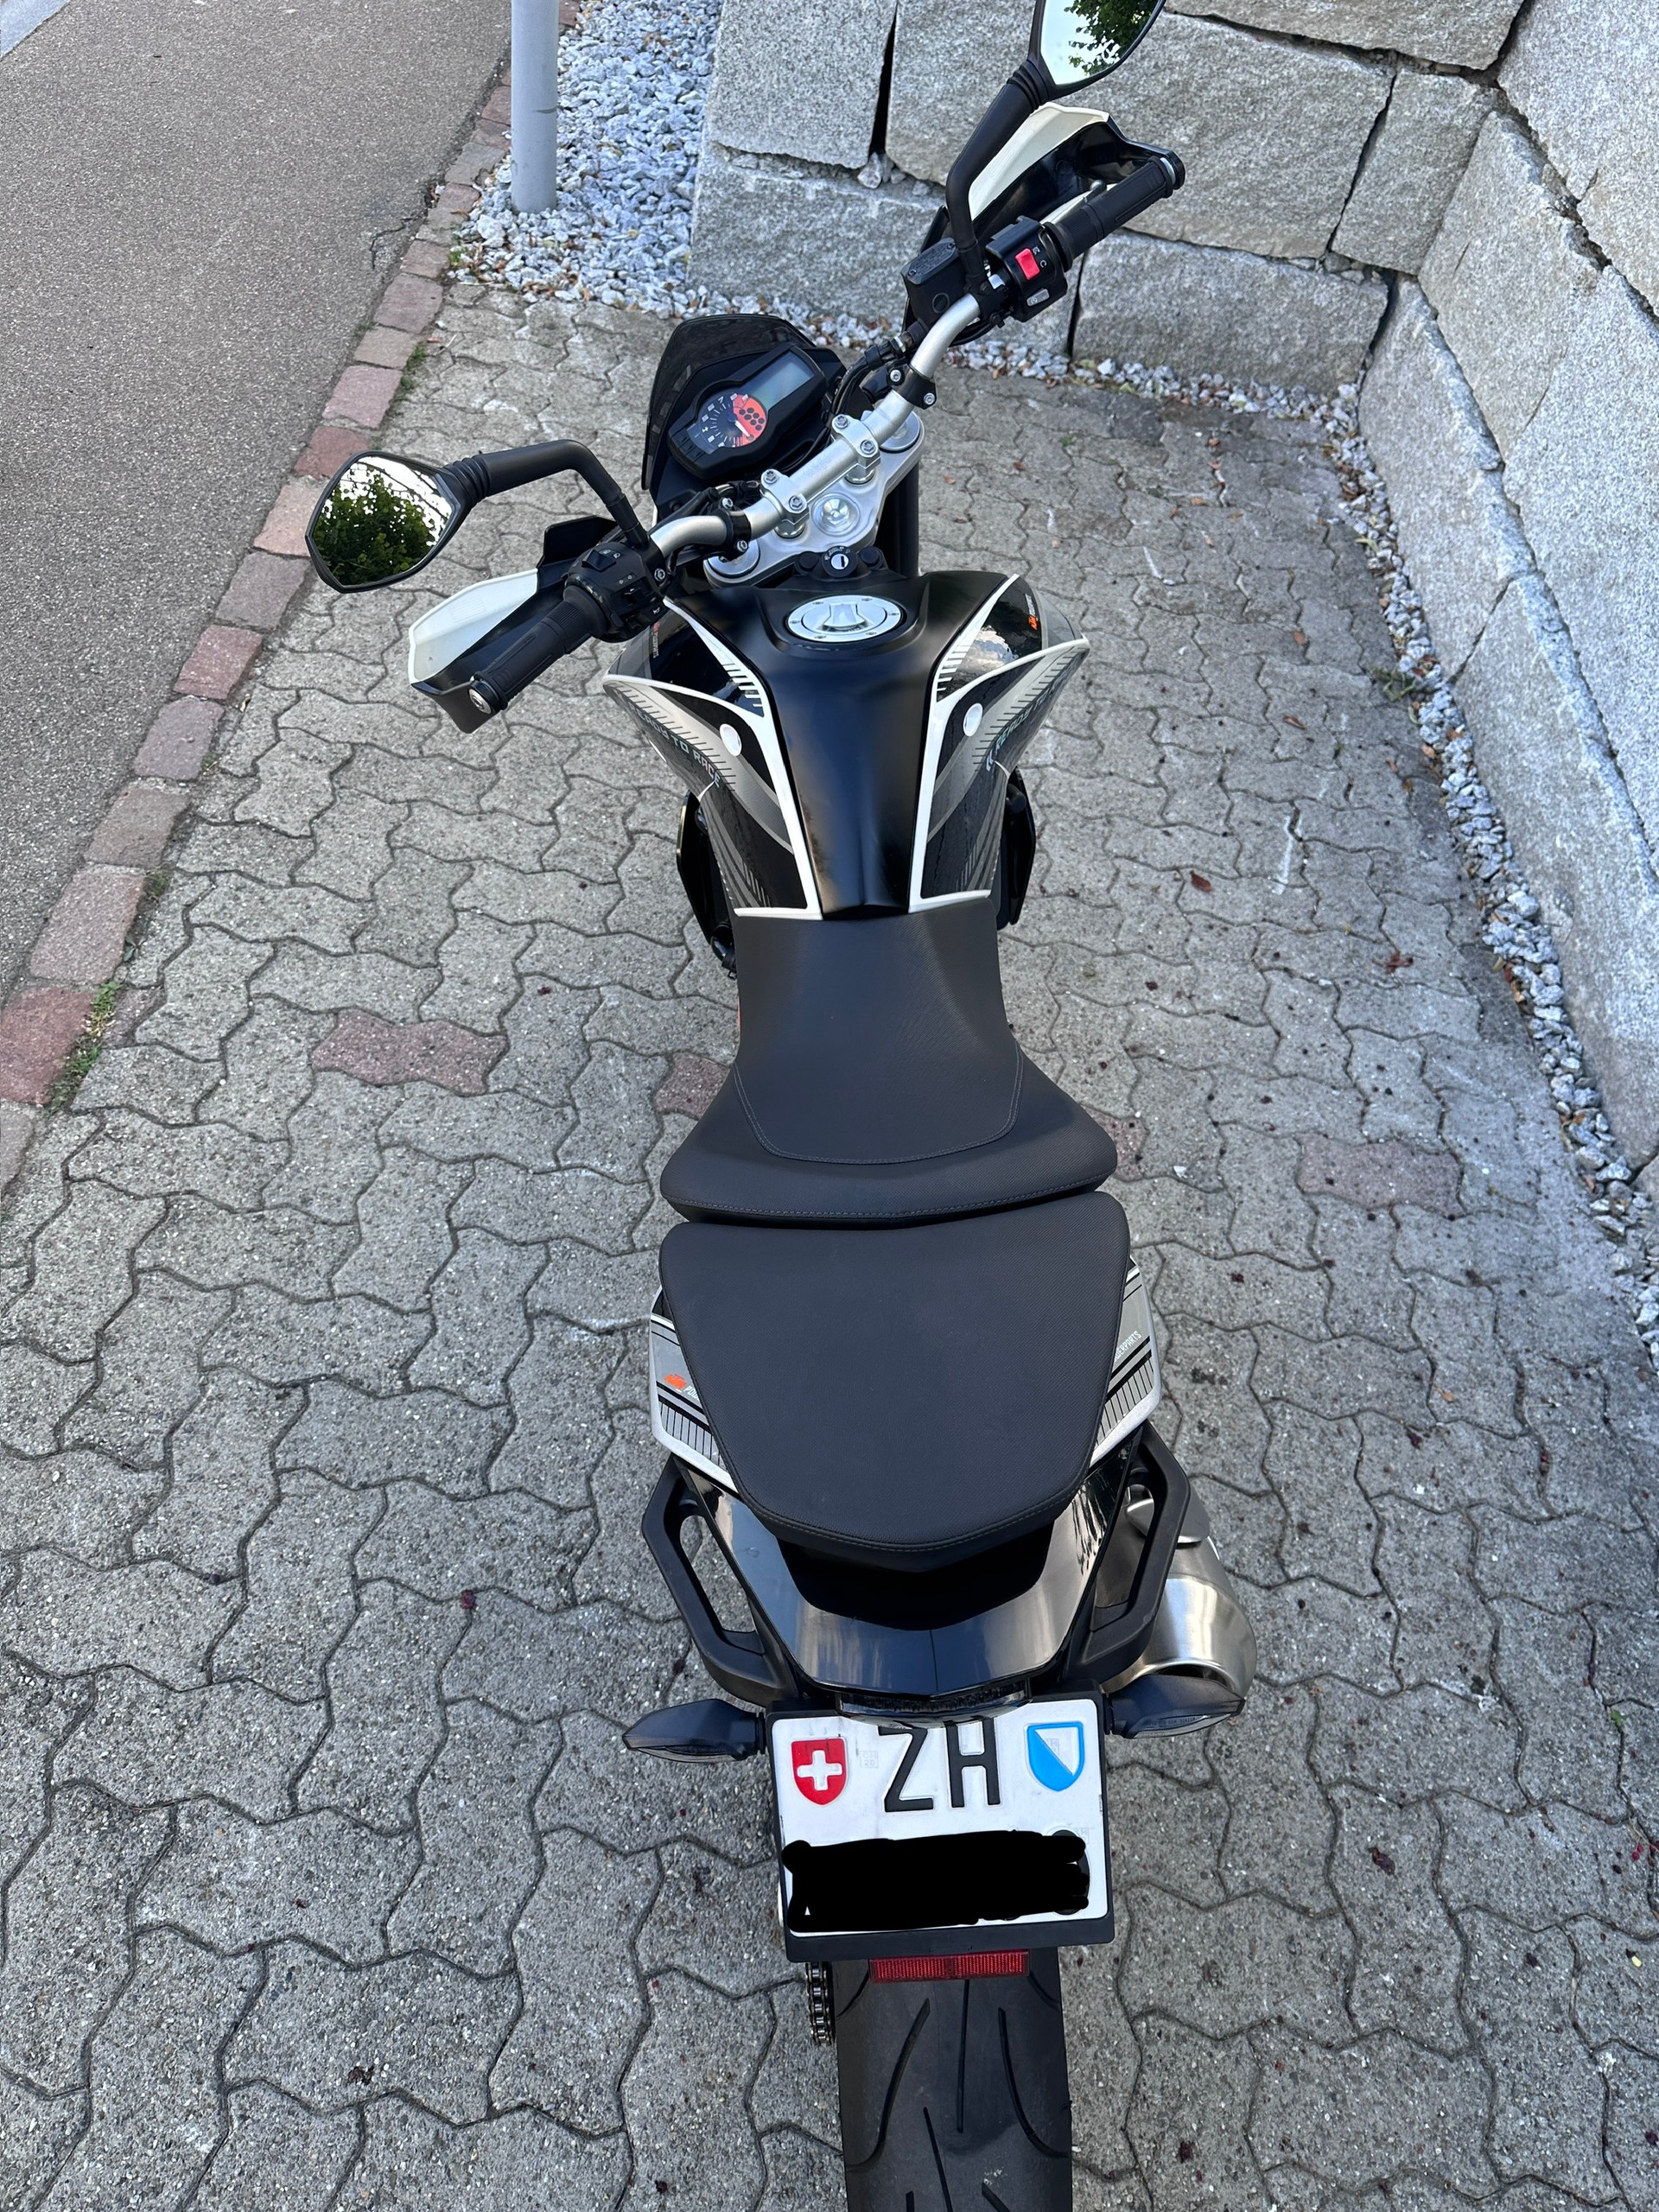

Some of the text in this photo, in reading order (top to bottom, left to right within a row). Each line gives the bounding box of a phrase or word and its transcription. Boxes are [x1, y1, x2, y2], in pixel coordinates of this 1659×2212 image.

[671, 734, 690, 754] TO
[692, 749, 721, 788] RACE
[1114, 1330, 1142, 1363] WERPARTS
[877, 1716, 1001, 1813] ZH
